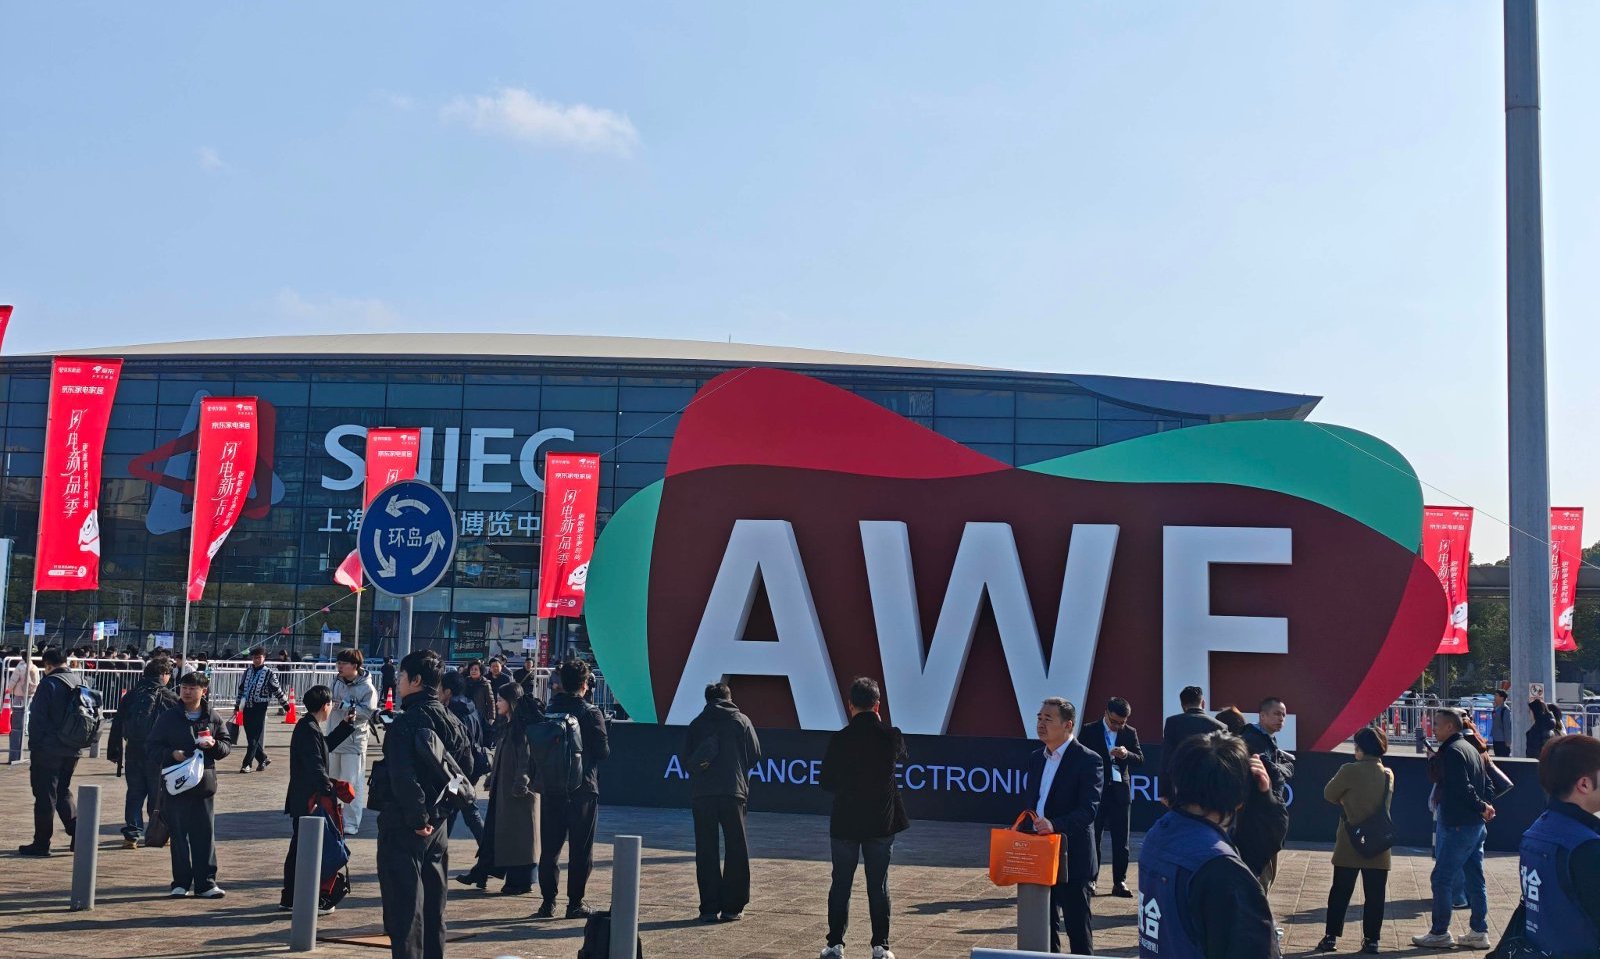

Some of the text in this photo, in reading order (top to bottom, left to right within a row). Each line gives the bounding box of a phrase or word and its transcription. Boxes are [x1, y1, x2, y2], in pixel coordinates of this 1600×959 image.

[61, 385, 104, 395] 京东家电家居
[211, 421, 251, 430] 京东家电家居
[60, 408, 88, 518] 闪电新品季
[321, 424, 575, 493] SIEC
[554, 472, 592, 480] 京东家电家居
[318, 508, 541, 537] 上海博览中
[388, 526, 423, 548] 环岛
[665, 519, 1297, 750] AWE
[663, 754, 1029, 795] AANCE ECTRONI
